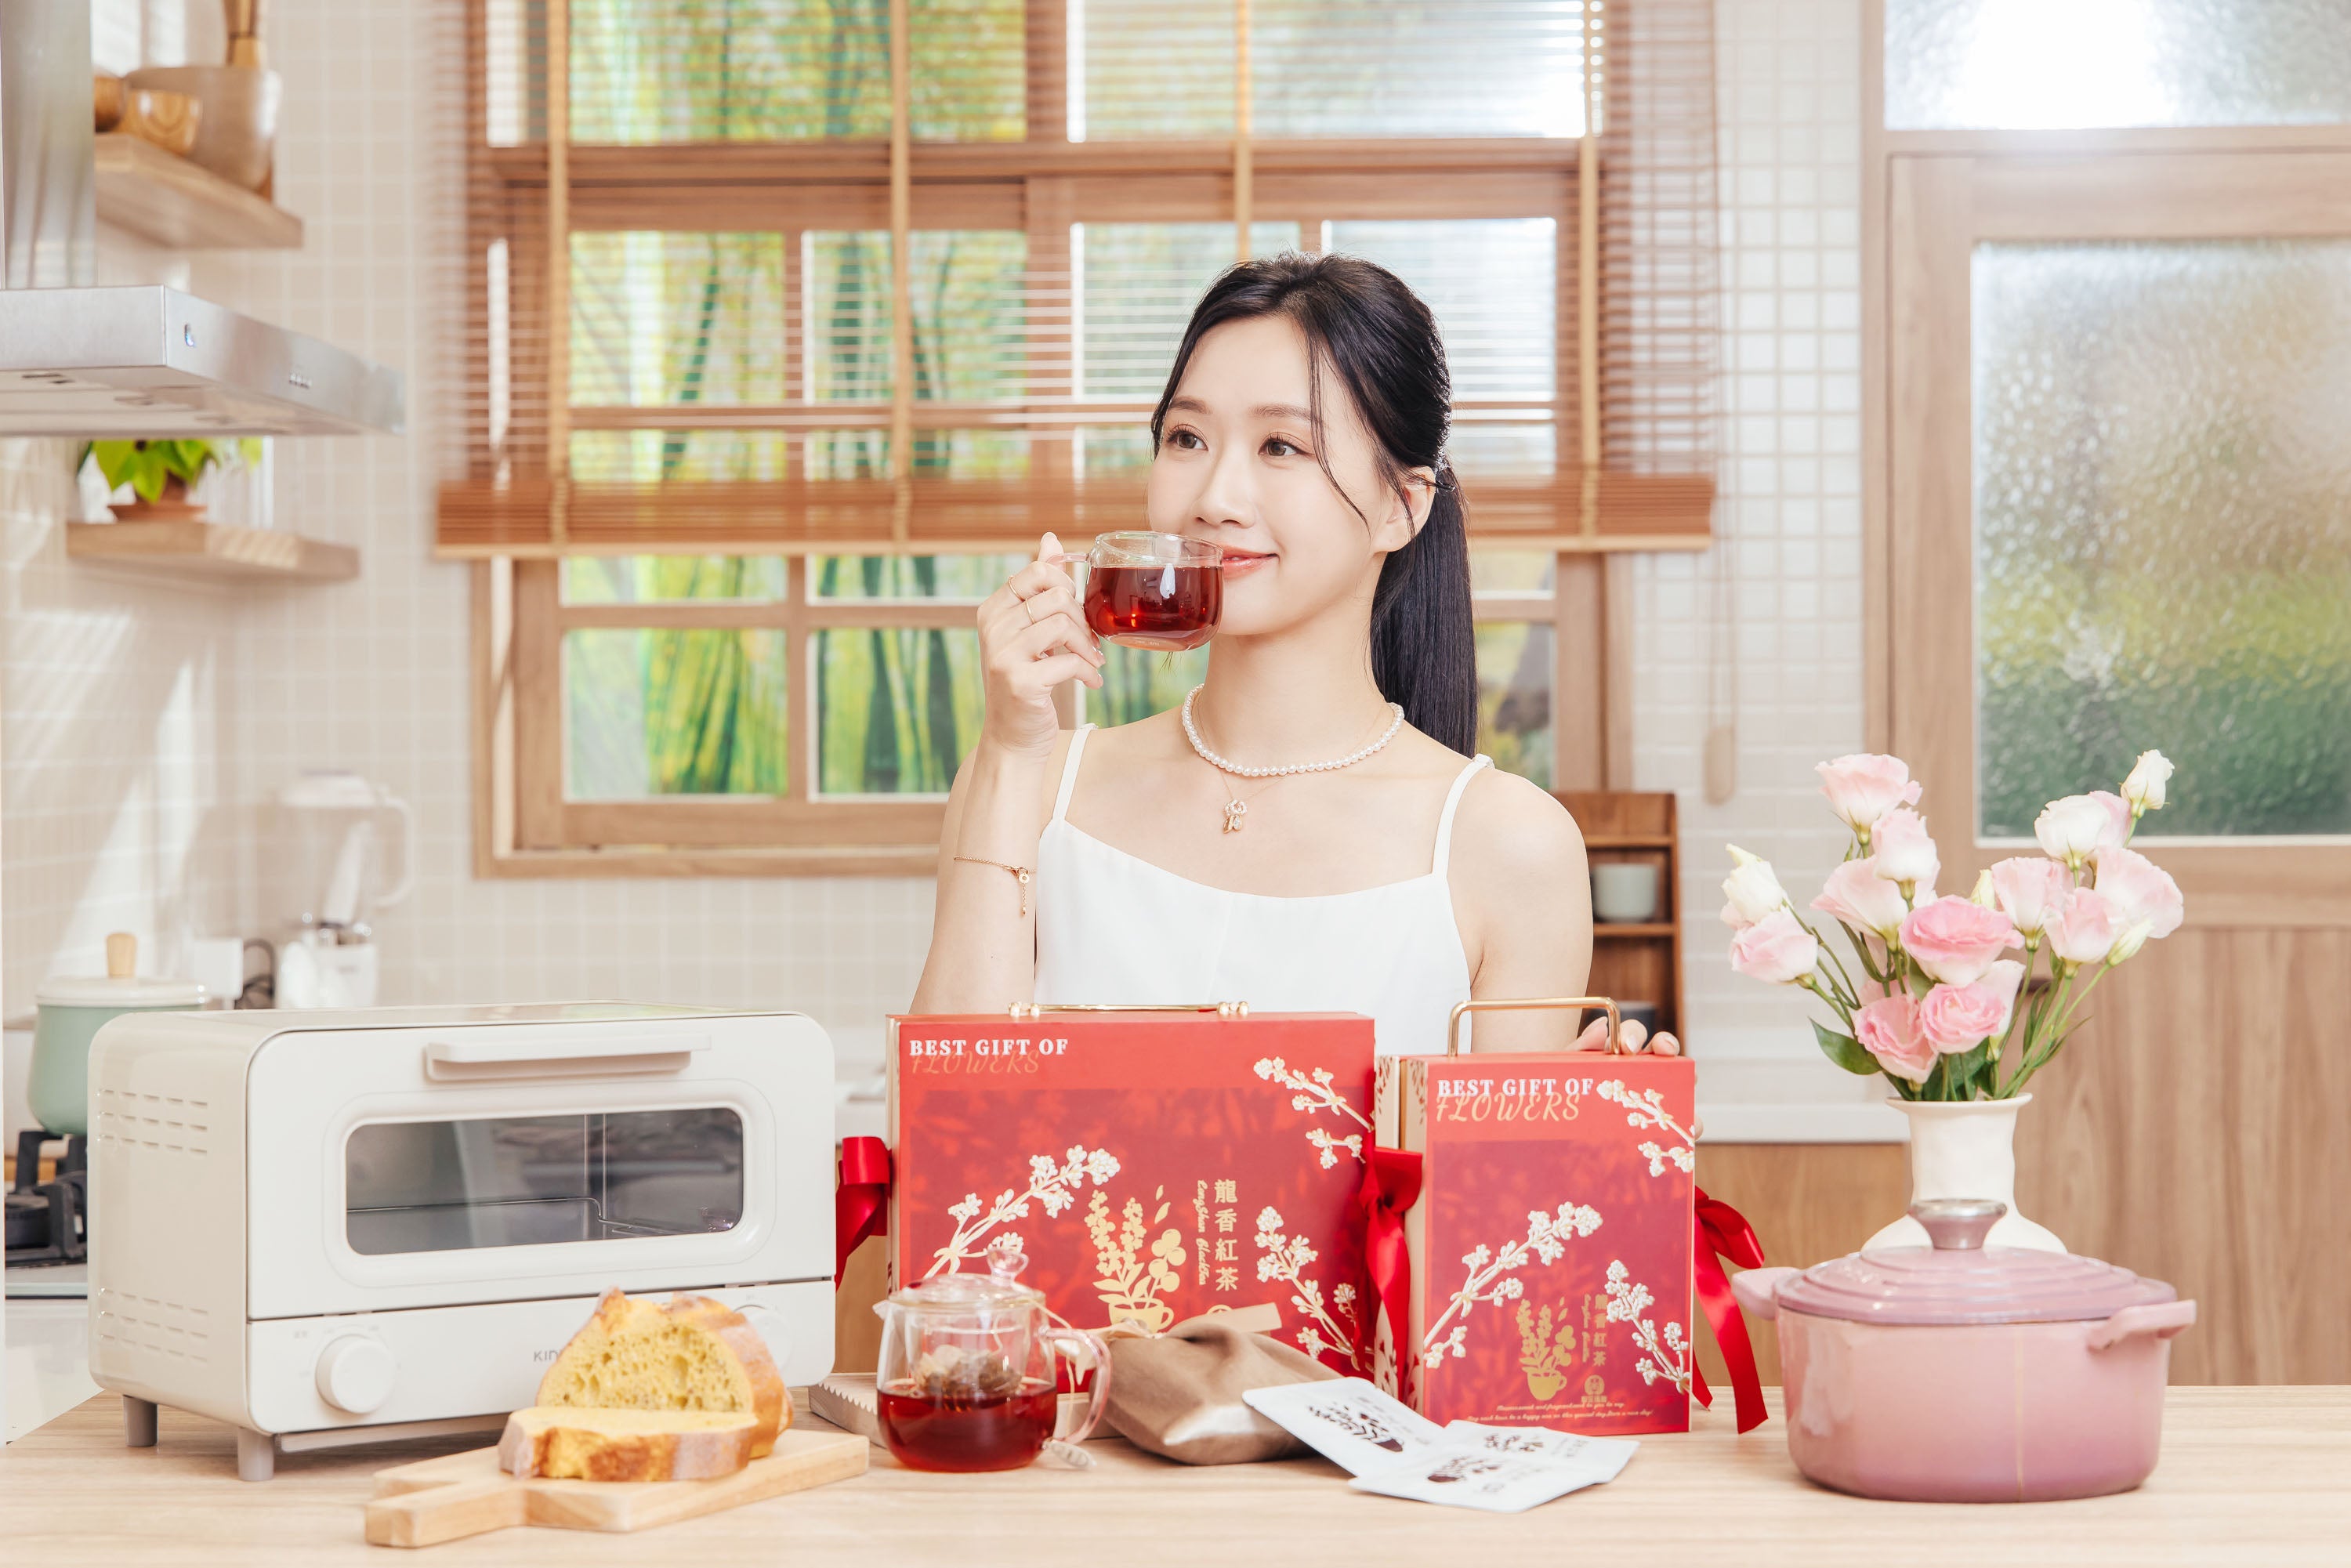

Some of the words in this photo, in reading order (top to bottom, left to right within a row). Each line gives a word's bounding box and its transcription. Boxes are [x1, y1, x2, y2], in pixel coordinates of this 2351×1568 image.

[909, 1039, 967, 1056] BEST
[975, 1038, 1031, 1056] GIFT
[1038, 1038, 1069, 1056] OF
[911, 1050, 1039, 1074] FLOWERS
[1437, 1079, 1494, 1097] BEST
[1502, 1078, 1556, 1097] GIFT
[1564, 1077, 1594, 1095] OF
[1436, 1092, 1581, 1122] FLOWERS
[1214, 1179, 1239, 1291] 龍香紅茶
